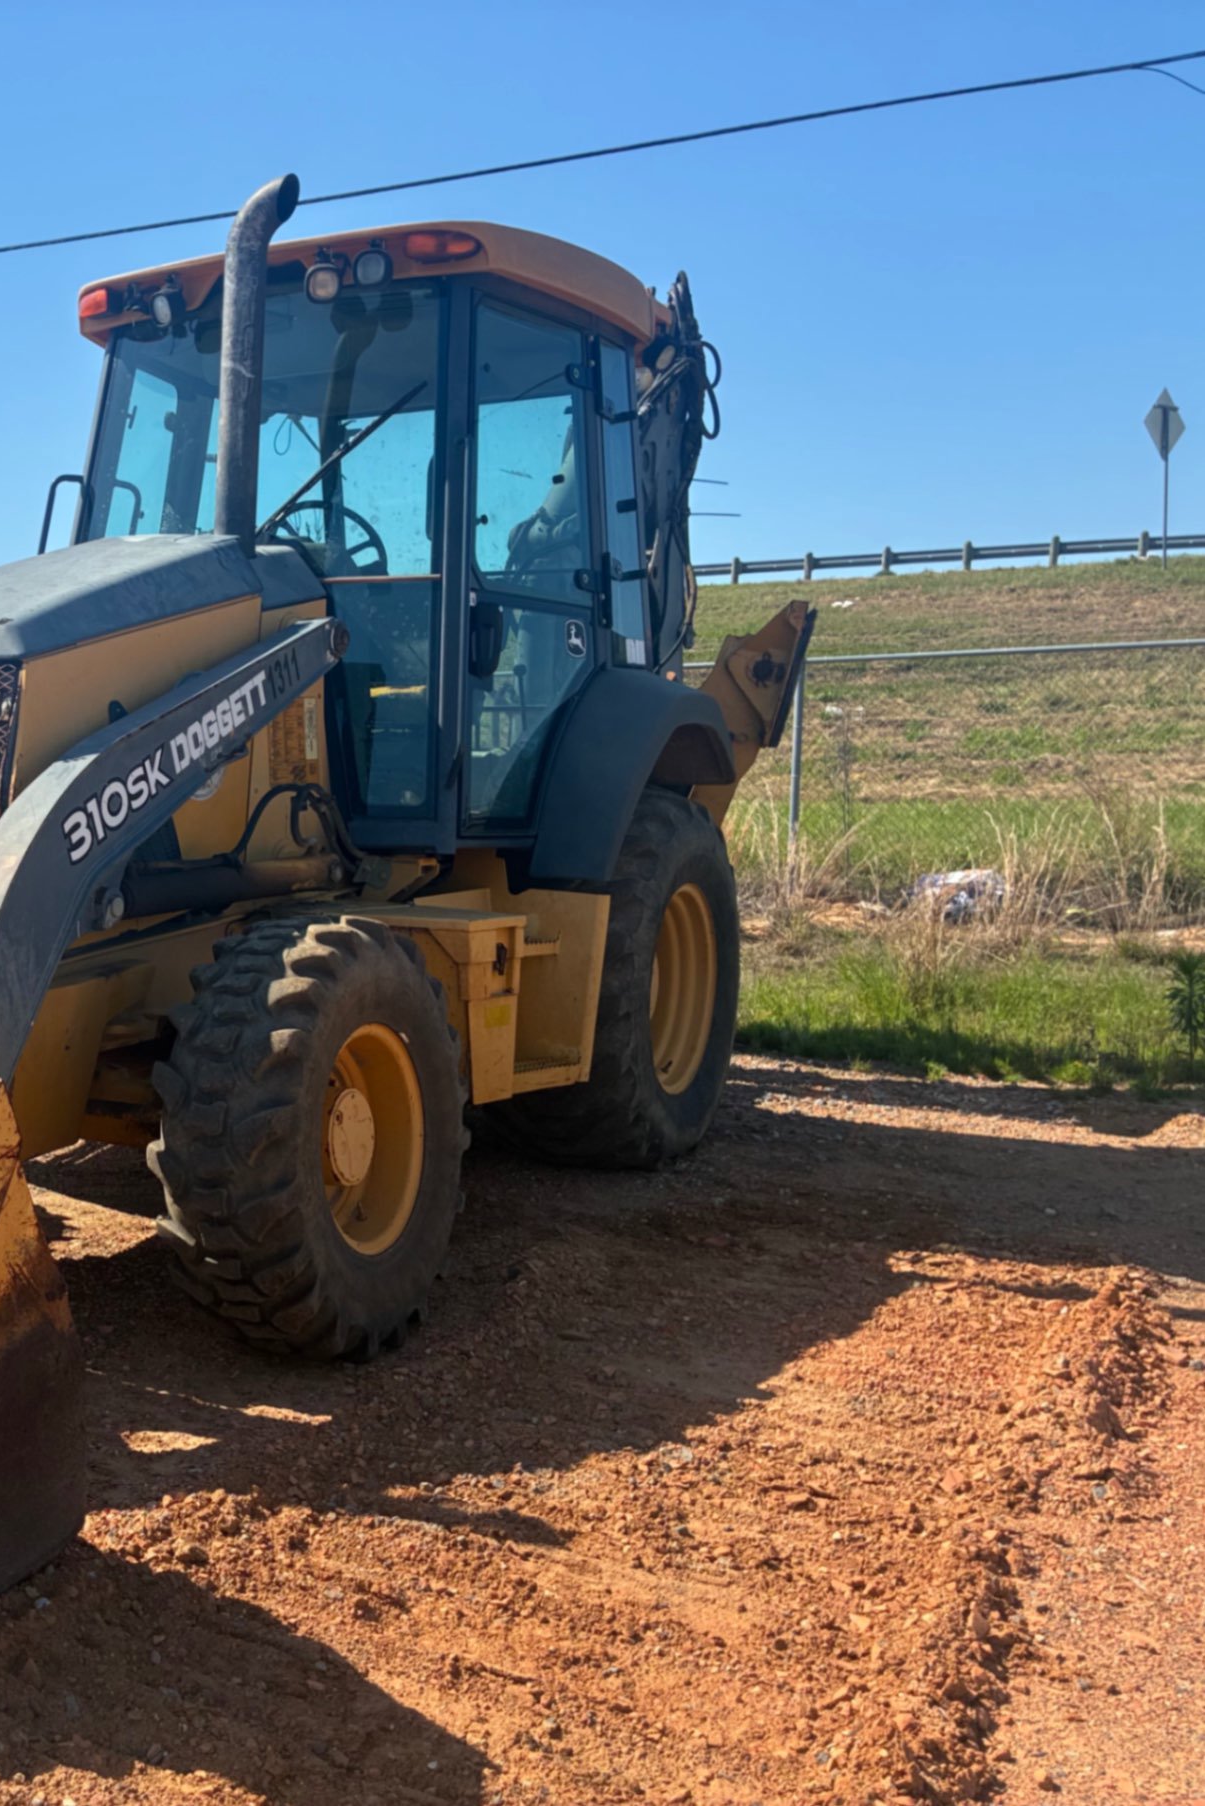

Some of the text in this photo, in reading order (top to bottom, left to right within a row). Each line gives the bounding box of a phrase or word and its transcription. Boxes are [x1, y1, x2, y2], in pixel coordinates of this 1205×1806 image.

[62, 747, 172, 863] 310SK
[169, 669, 268, 775] DOGGETT
[267, 647, 301, 700] 1311
